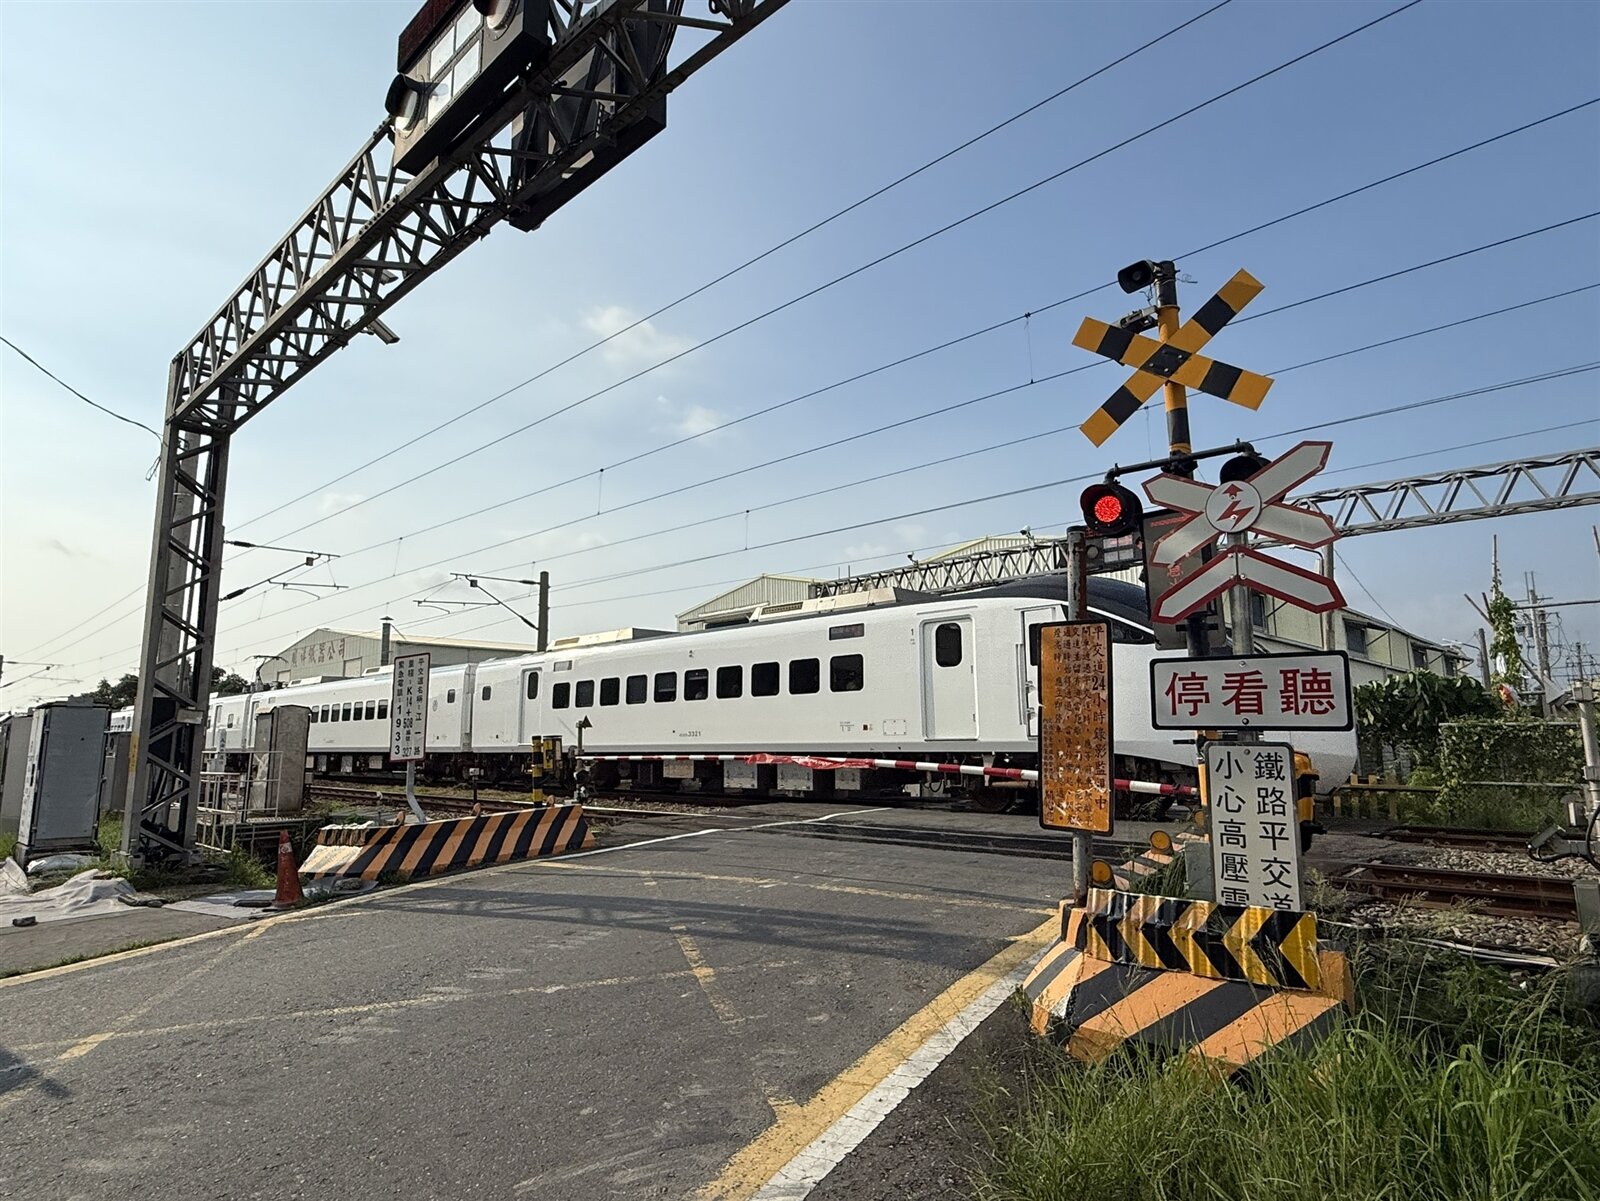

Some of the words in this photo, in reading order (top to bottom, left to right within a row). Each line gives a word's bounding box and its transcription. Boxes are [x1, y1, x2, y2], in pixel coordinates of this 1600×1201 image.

[1164, 667, 1336, 716] 停看聽
[1253, 751, 1294, 910] 鐵路平交道
